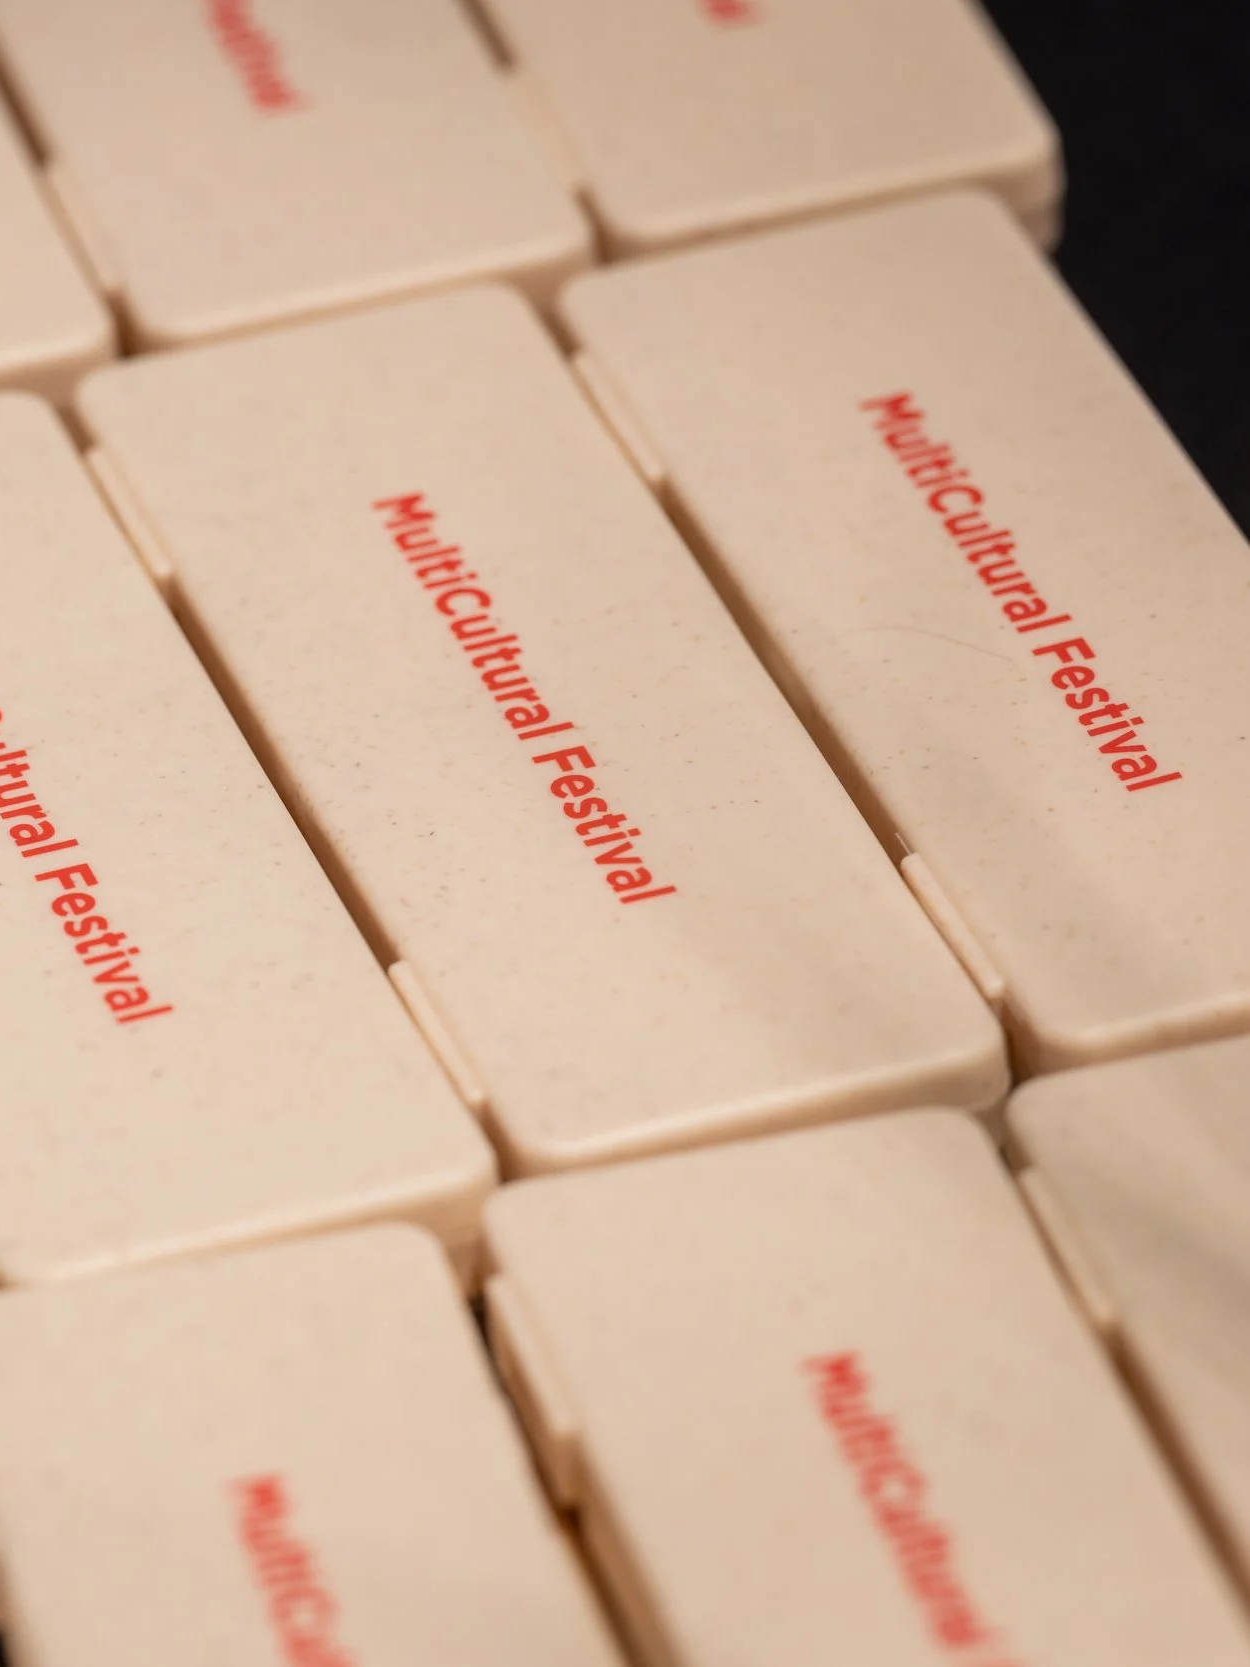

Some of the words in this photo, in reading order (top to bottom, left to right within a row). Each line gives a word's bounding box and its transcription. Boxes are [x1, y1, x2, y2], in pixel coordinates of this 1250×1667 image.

[371, 491, 575, 742] MultiCultural
[531, 743, 677, 905] Festival
[862, 391, 1073, 634] MultiCultural
[1030, 636, 1183, 793] Festival
[32, 861, 174, 1025] Festival
